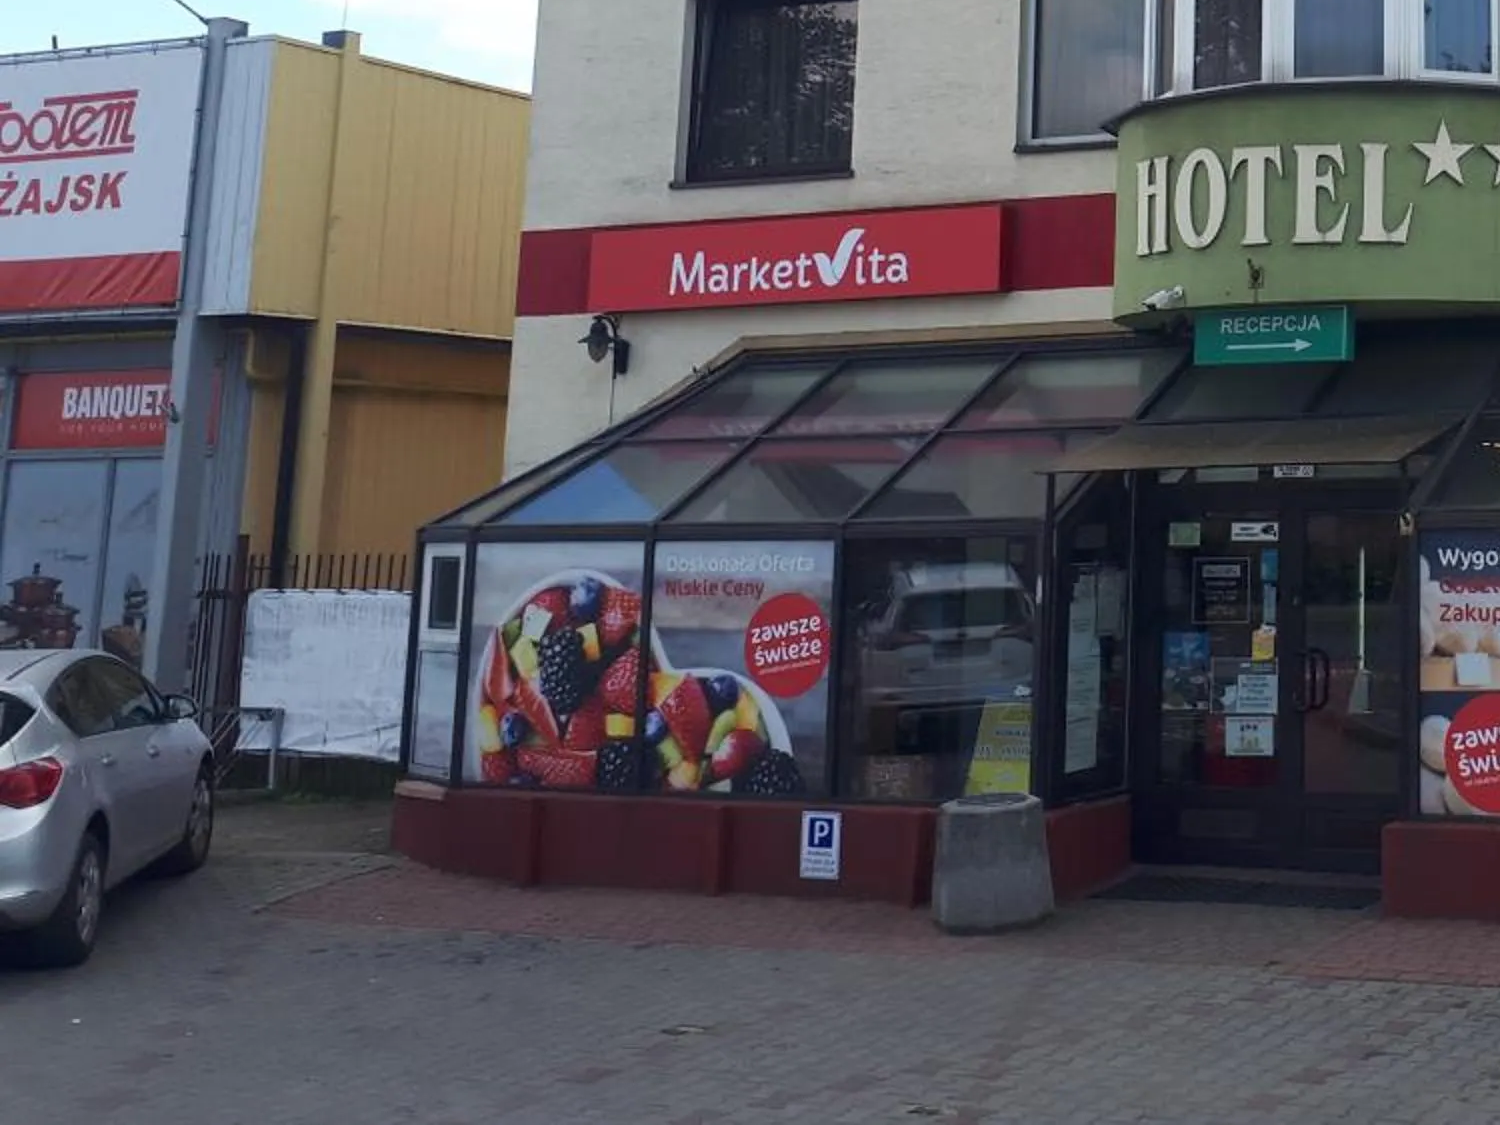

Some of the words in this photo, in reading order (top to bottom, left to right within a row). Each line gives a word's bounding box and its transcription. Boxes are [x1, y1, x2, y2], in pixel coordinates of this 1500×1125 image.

[1136, 142, 1414, 257] HOTEL
[1220, 314, 1321, 334] RECEPCJA
[62, 383, 168, 420] BANQUET
[665, 579, 719, 597] Niskie
[722, 579, 765, 600] Ceny
[751, 615, 821, 644] zawsze
[754, 636, 822, 667] świeże
